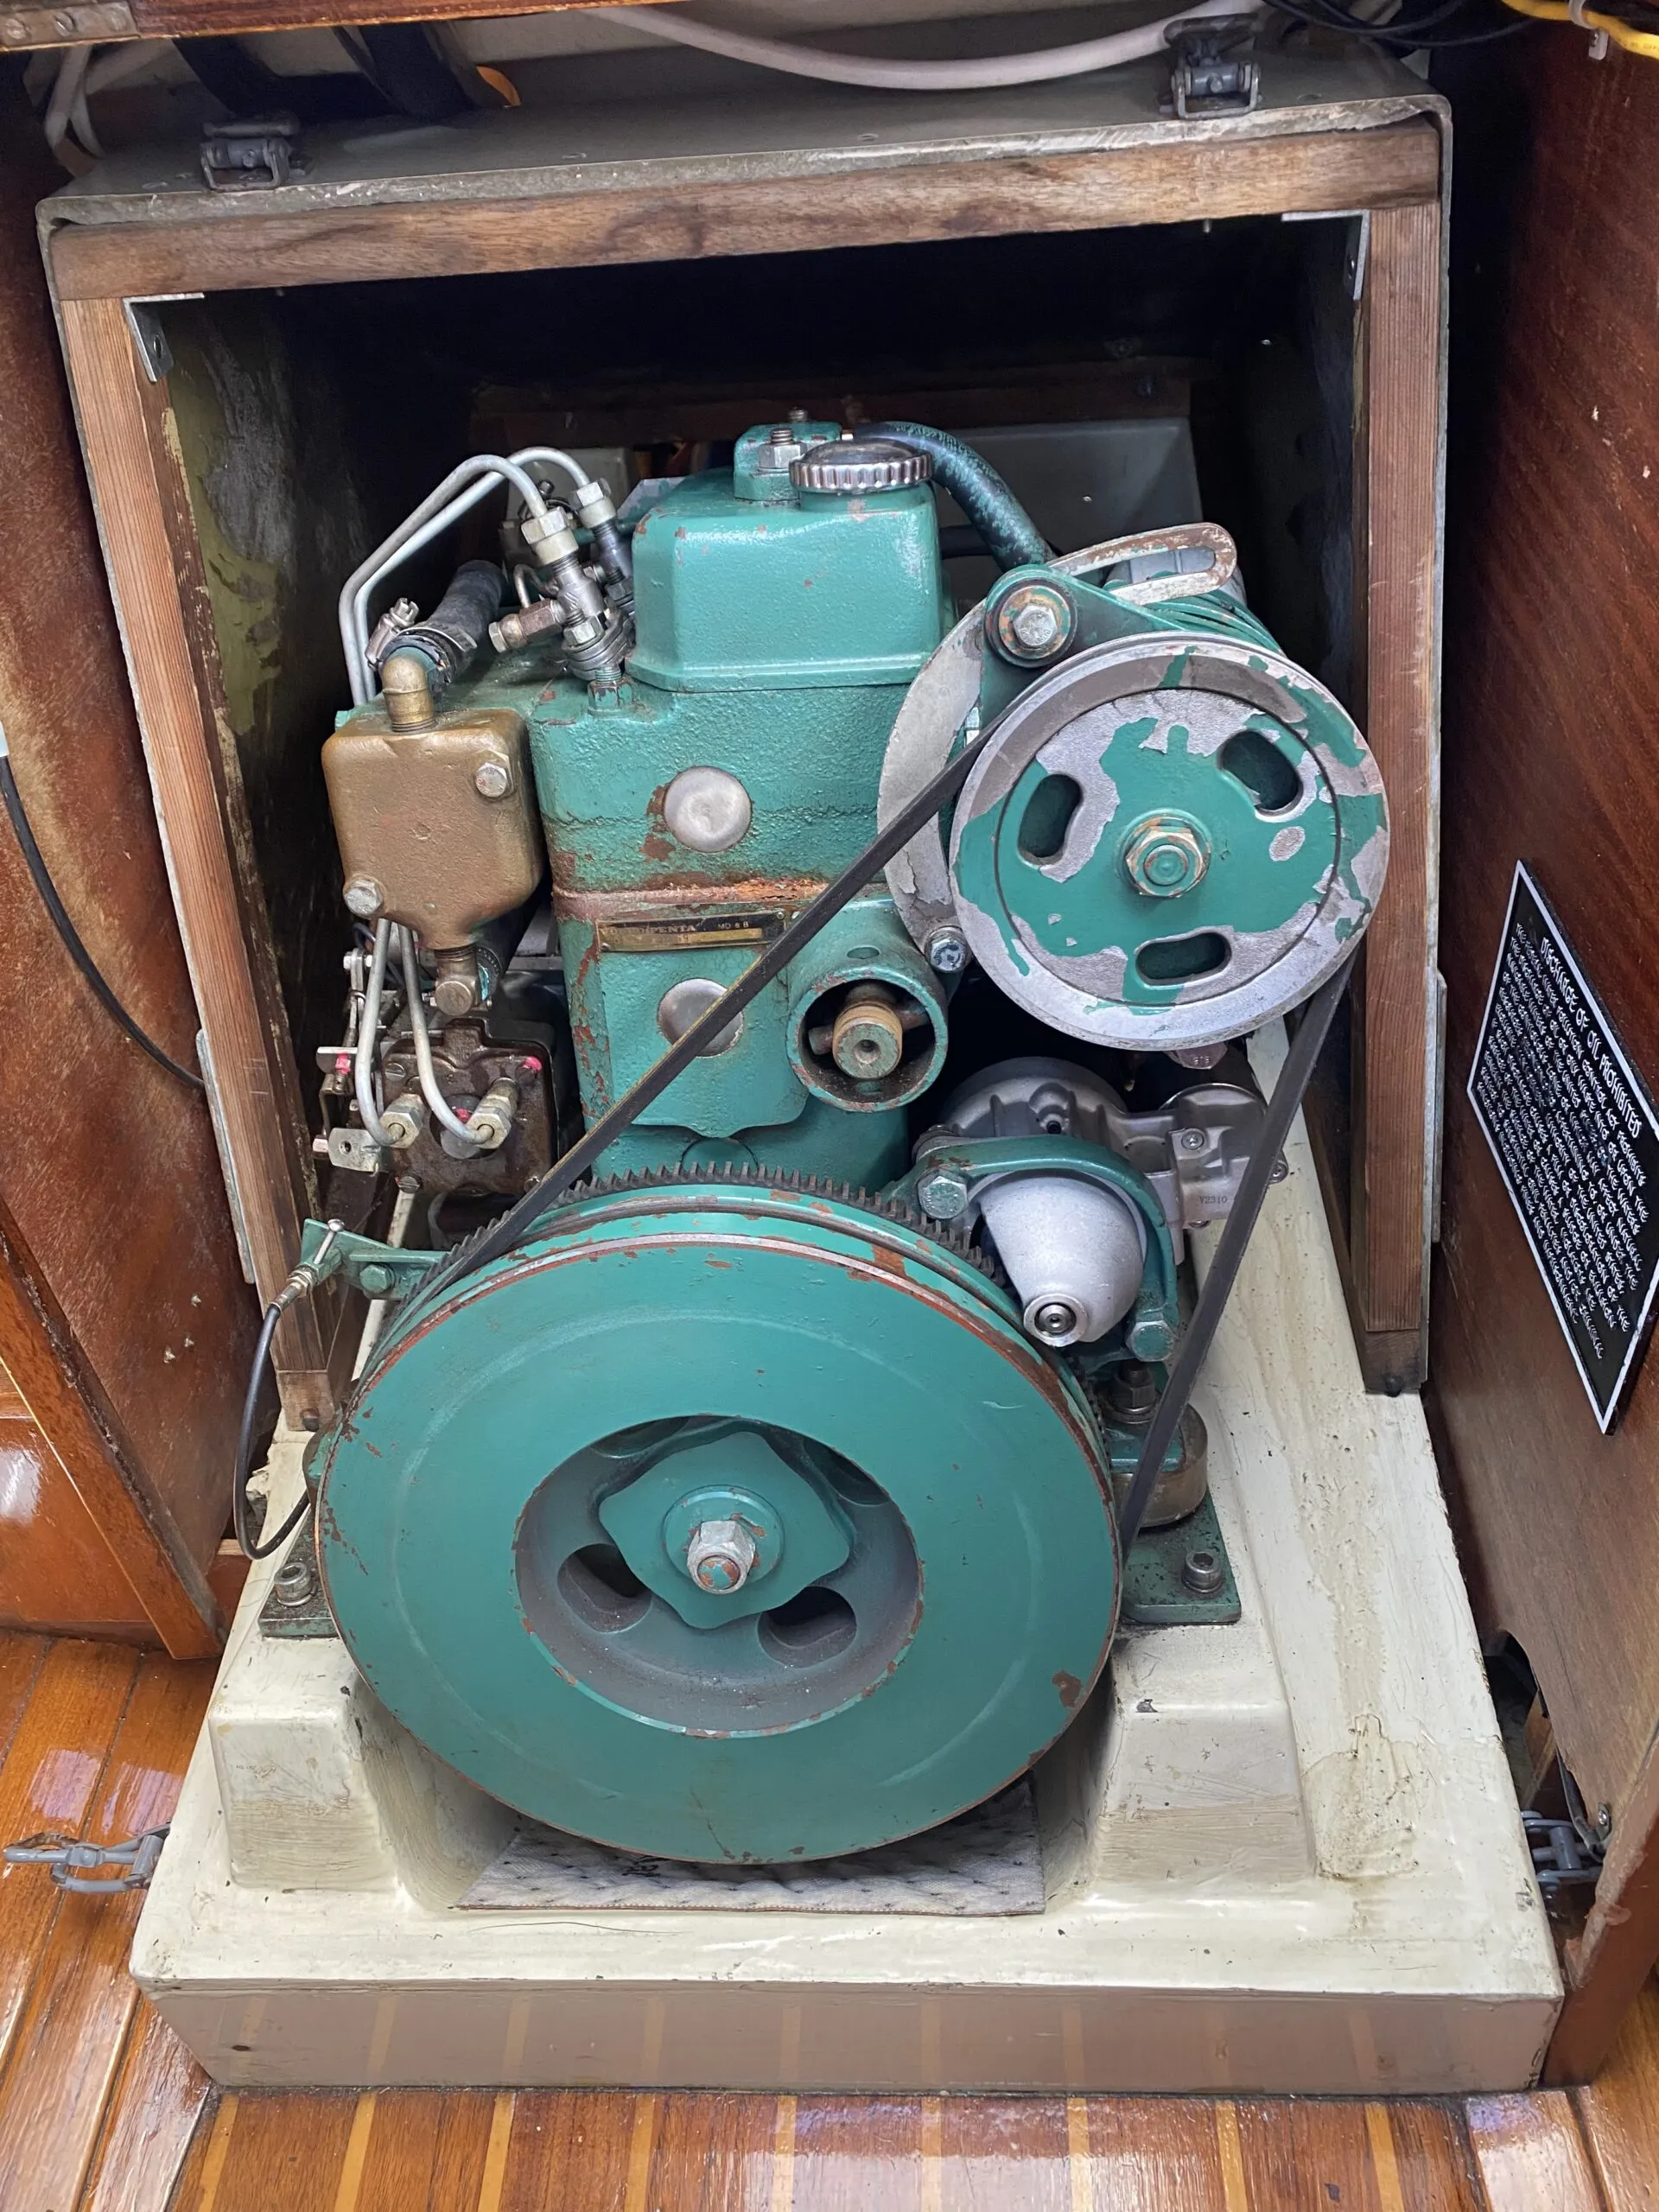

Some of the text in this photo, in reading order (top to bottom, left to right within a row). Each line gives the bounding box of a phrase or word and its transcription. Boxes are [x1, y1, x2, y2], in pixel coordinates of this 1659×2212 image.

[650, 924, 696, 934] PENTA
[1541, 937, 1642, 1138] DISCHARGE OF OIL PROHIBITED
